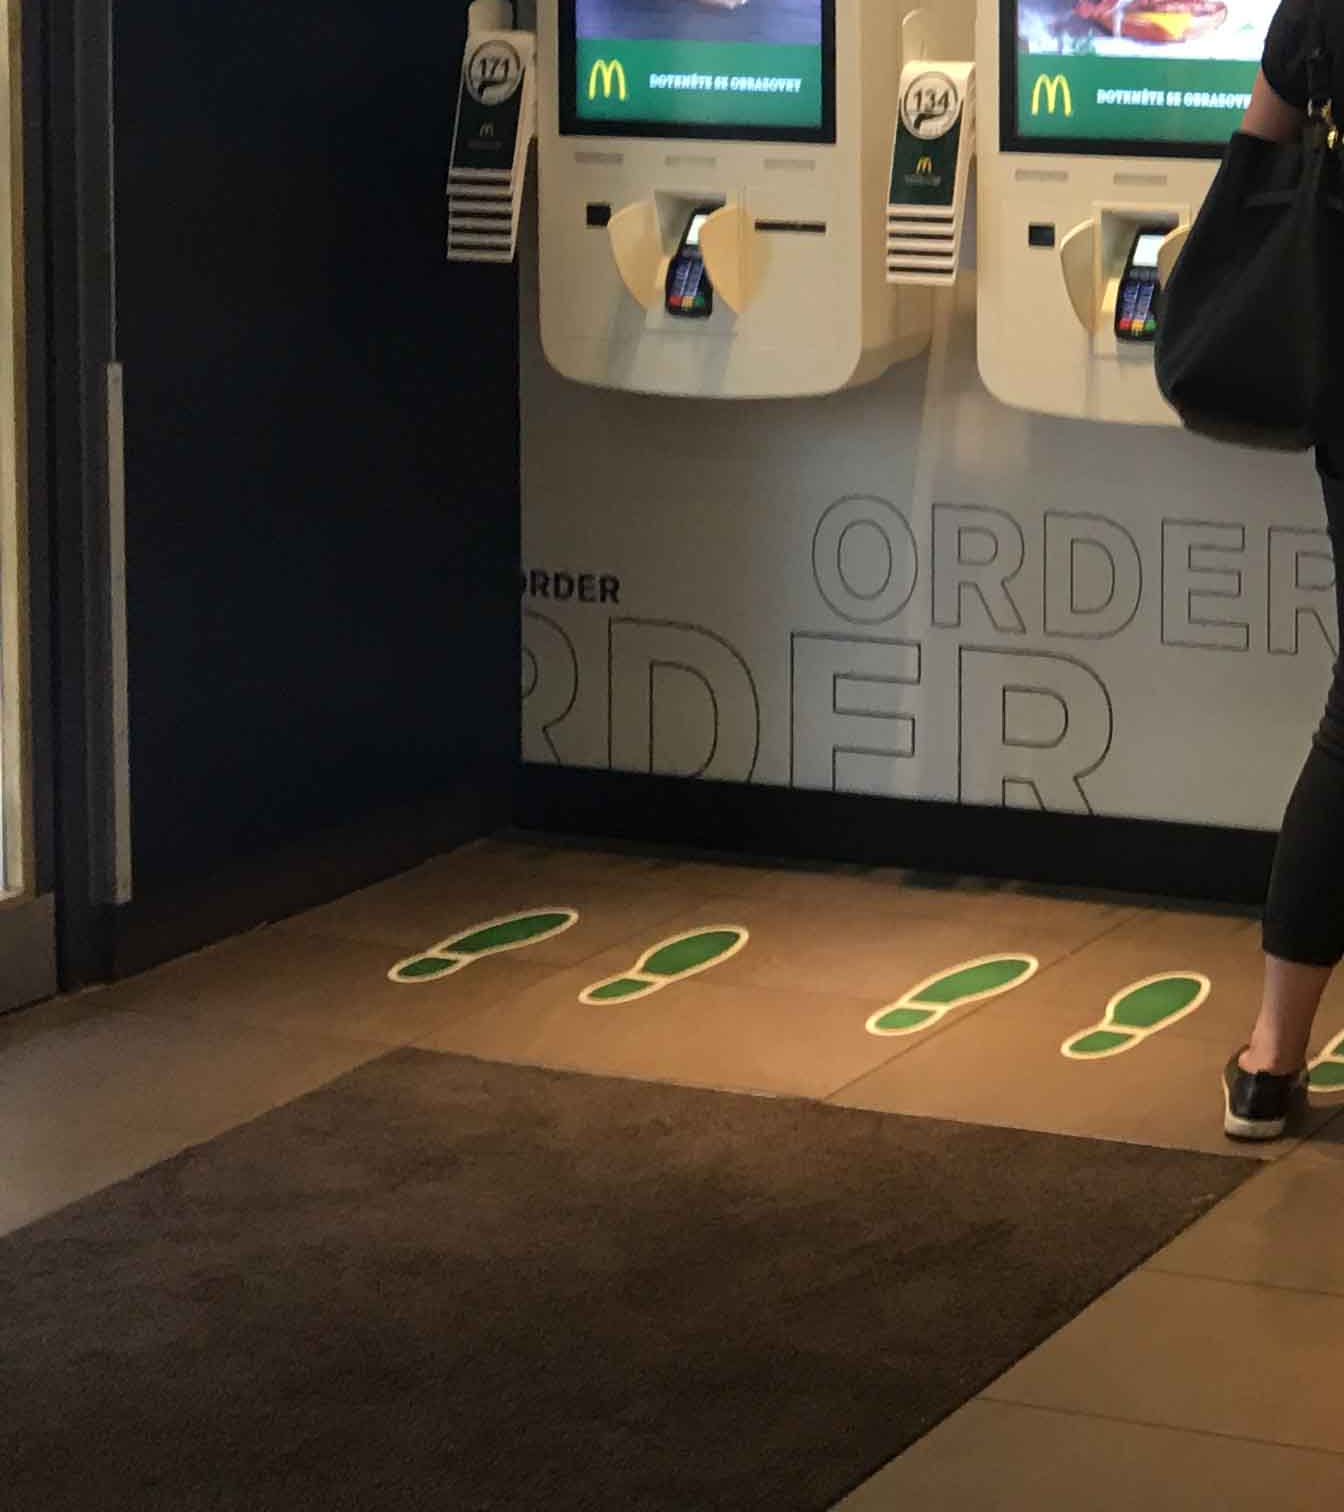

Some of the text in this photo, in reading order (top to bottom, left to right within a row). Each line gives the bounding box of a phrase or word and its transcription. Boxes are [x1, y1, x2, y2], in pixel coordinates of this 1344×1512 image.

[478, 57, 510, 78] 171
[913, 88, 949, 109] 134
[523, 570, 620, 604] RDER
[812, 495, 1338, 658] ORDER
